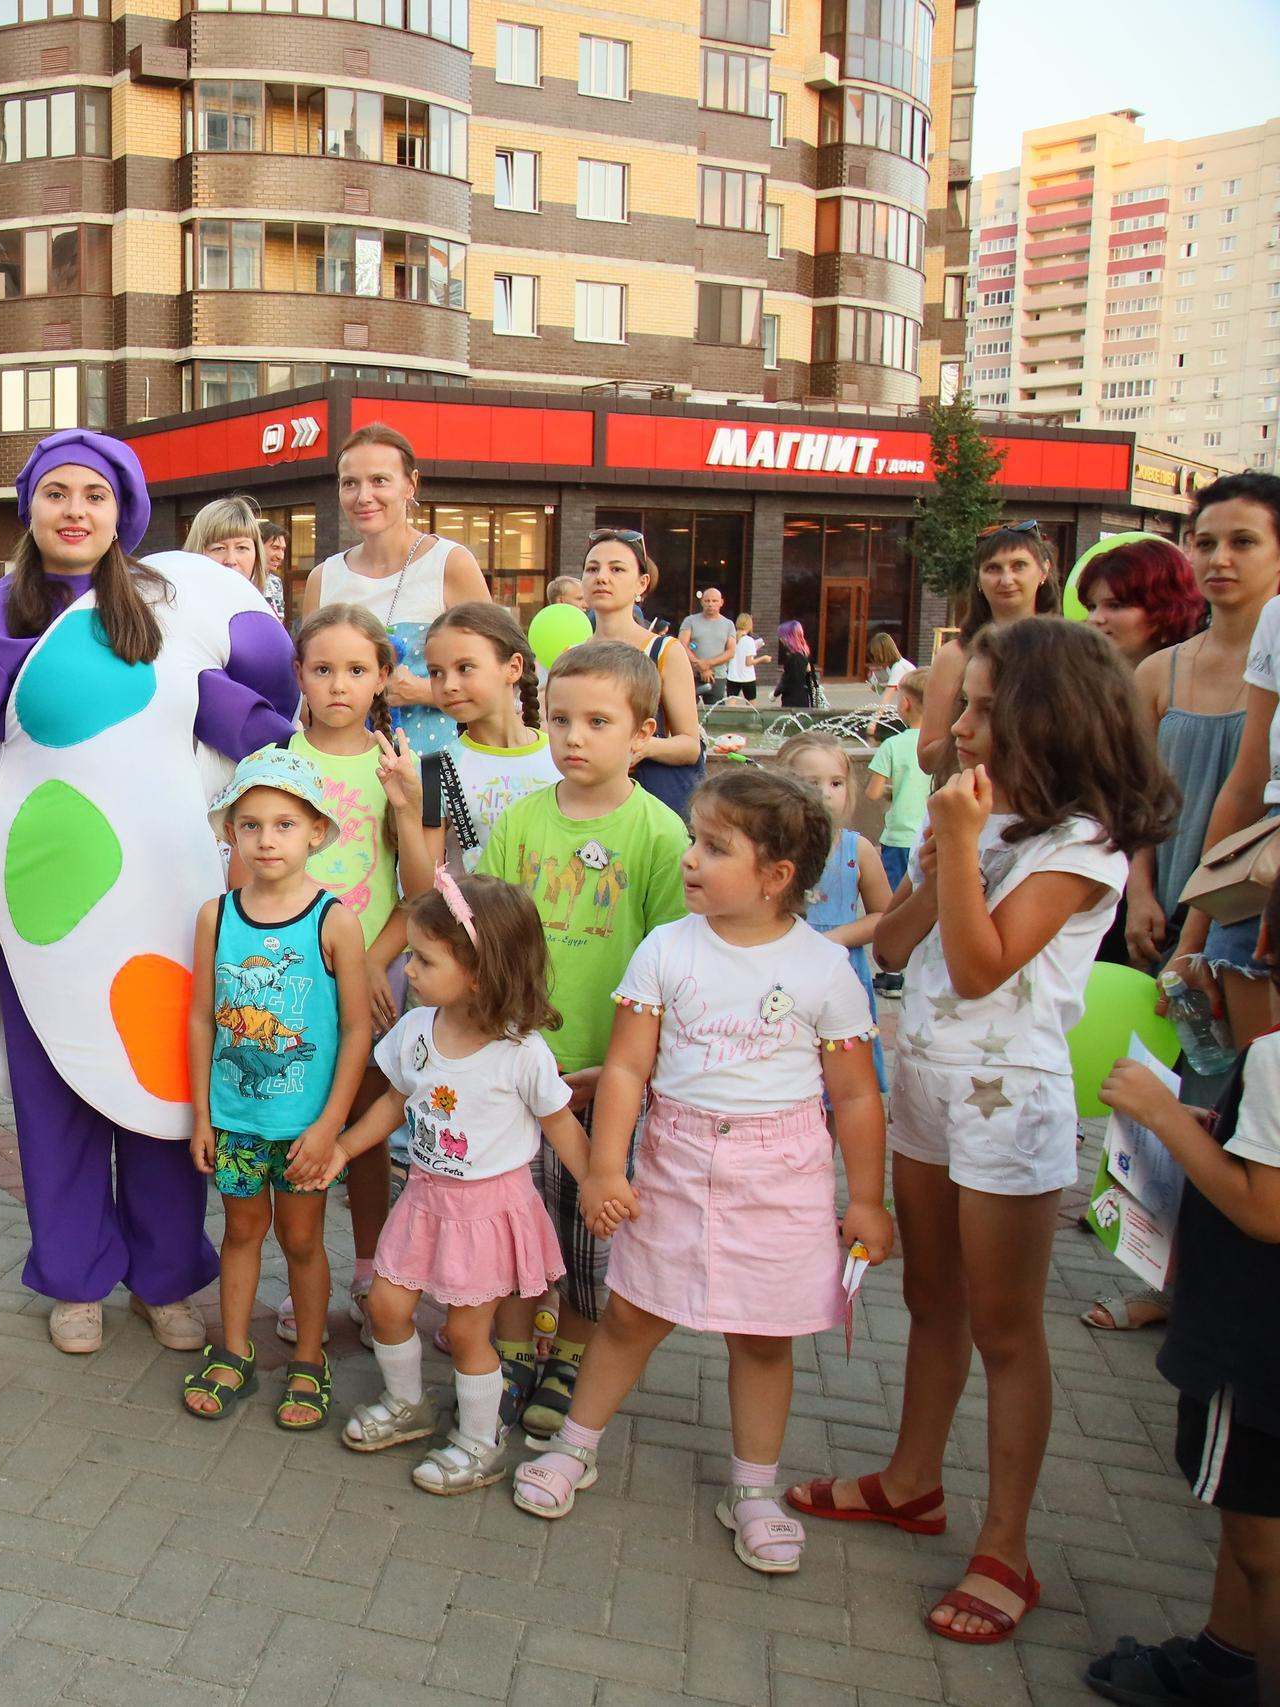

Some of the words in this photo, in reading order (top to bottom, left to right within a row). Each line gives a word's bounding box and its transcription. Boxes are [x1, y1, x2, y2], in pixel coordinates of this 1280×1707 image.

[705, 427, 879, 474] МАГНИТ
[874, 457, 887, 475] у
[887, 458, 925, 475] дома
[444, 770, 455, 787] ONLY
[452, 797, 466, 825] LIMITED
[461, 824, 472, 843] TIME
